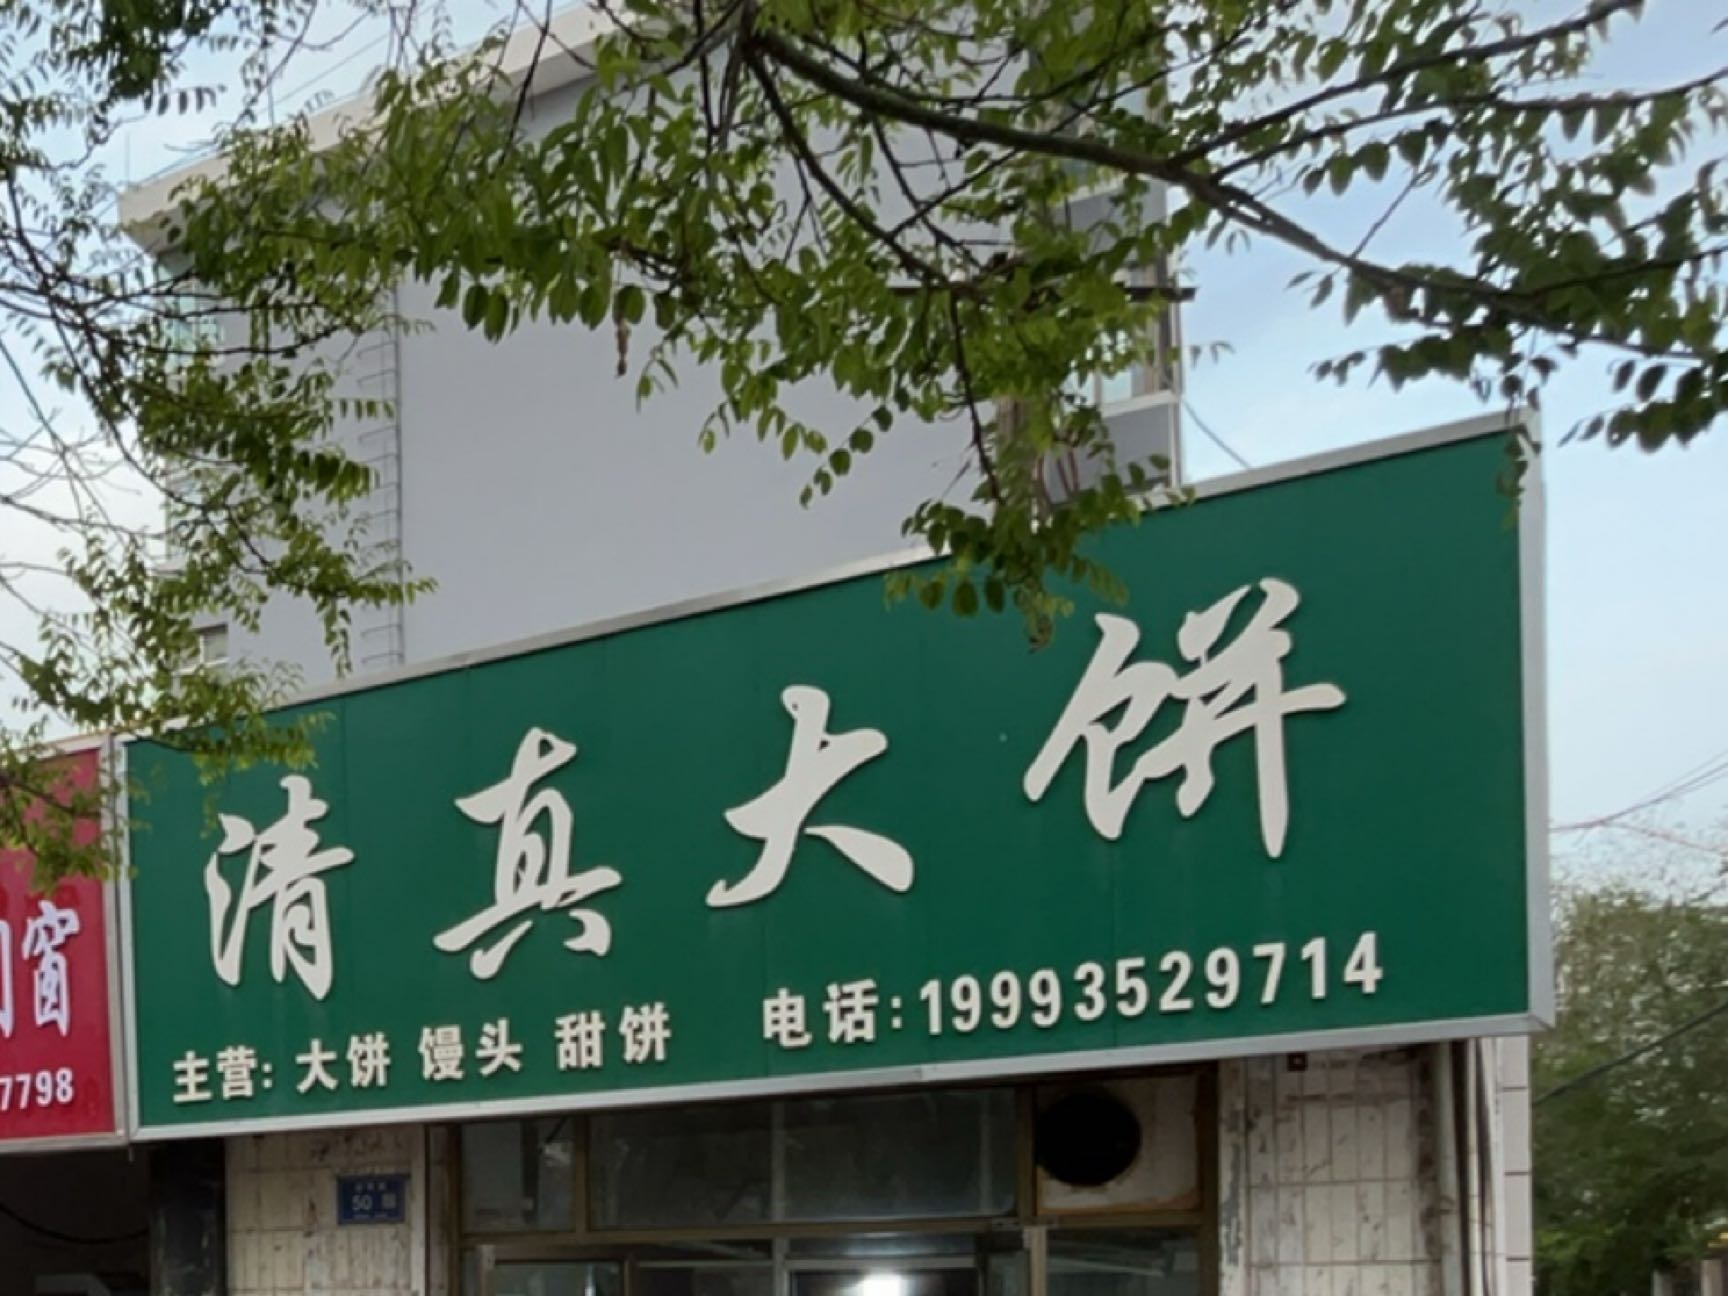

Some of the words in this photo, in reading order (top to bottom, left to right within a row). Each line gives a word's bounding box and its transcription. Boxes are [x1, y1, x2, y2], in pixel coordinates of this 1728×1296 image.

[202, 576, 1347, 1000] 清真大饼
[296, 1033, 391, 1094] 大饼
[419, 1019, 523, 1081] 馒头
[555, 1002, 672, 1070] 甜饼
[762, 931, 1384, 1048] 电话:19993529714
